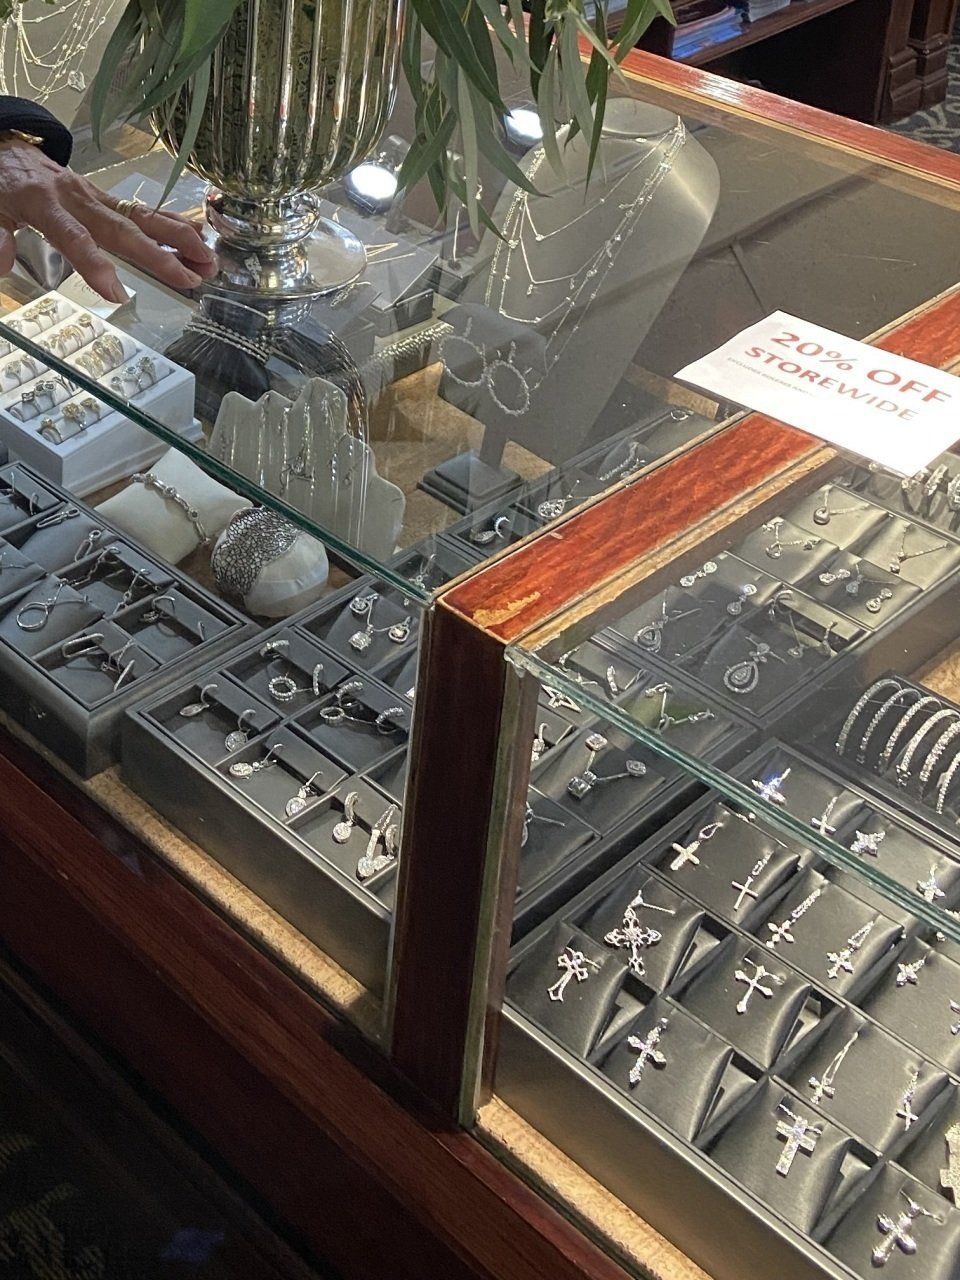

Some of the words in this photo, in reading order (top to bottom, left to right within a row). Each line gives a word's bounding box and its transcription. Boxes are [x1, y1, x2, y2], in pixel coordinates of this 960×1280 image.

[743, 346, 921, 422] STOREWIDE
[769, 330, 861, 373] 20%
[865, 368, 953, 406] OFF
